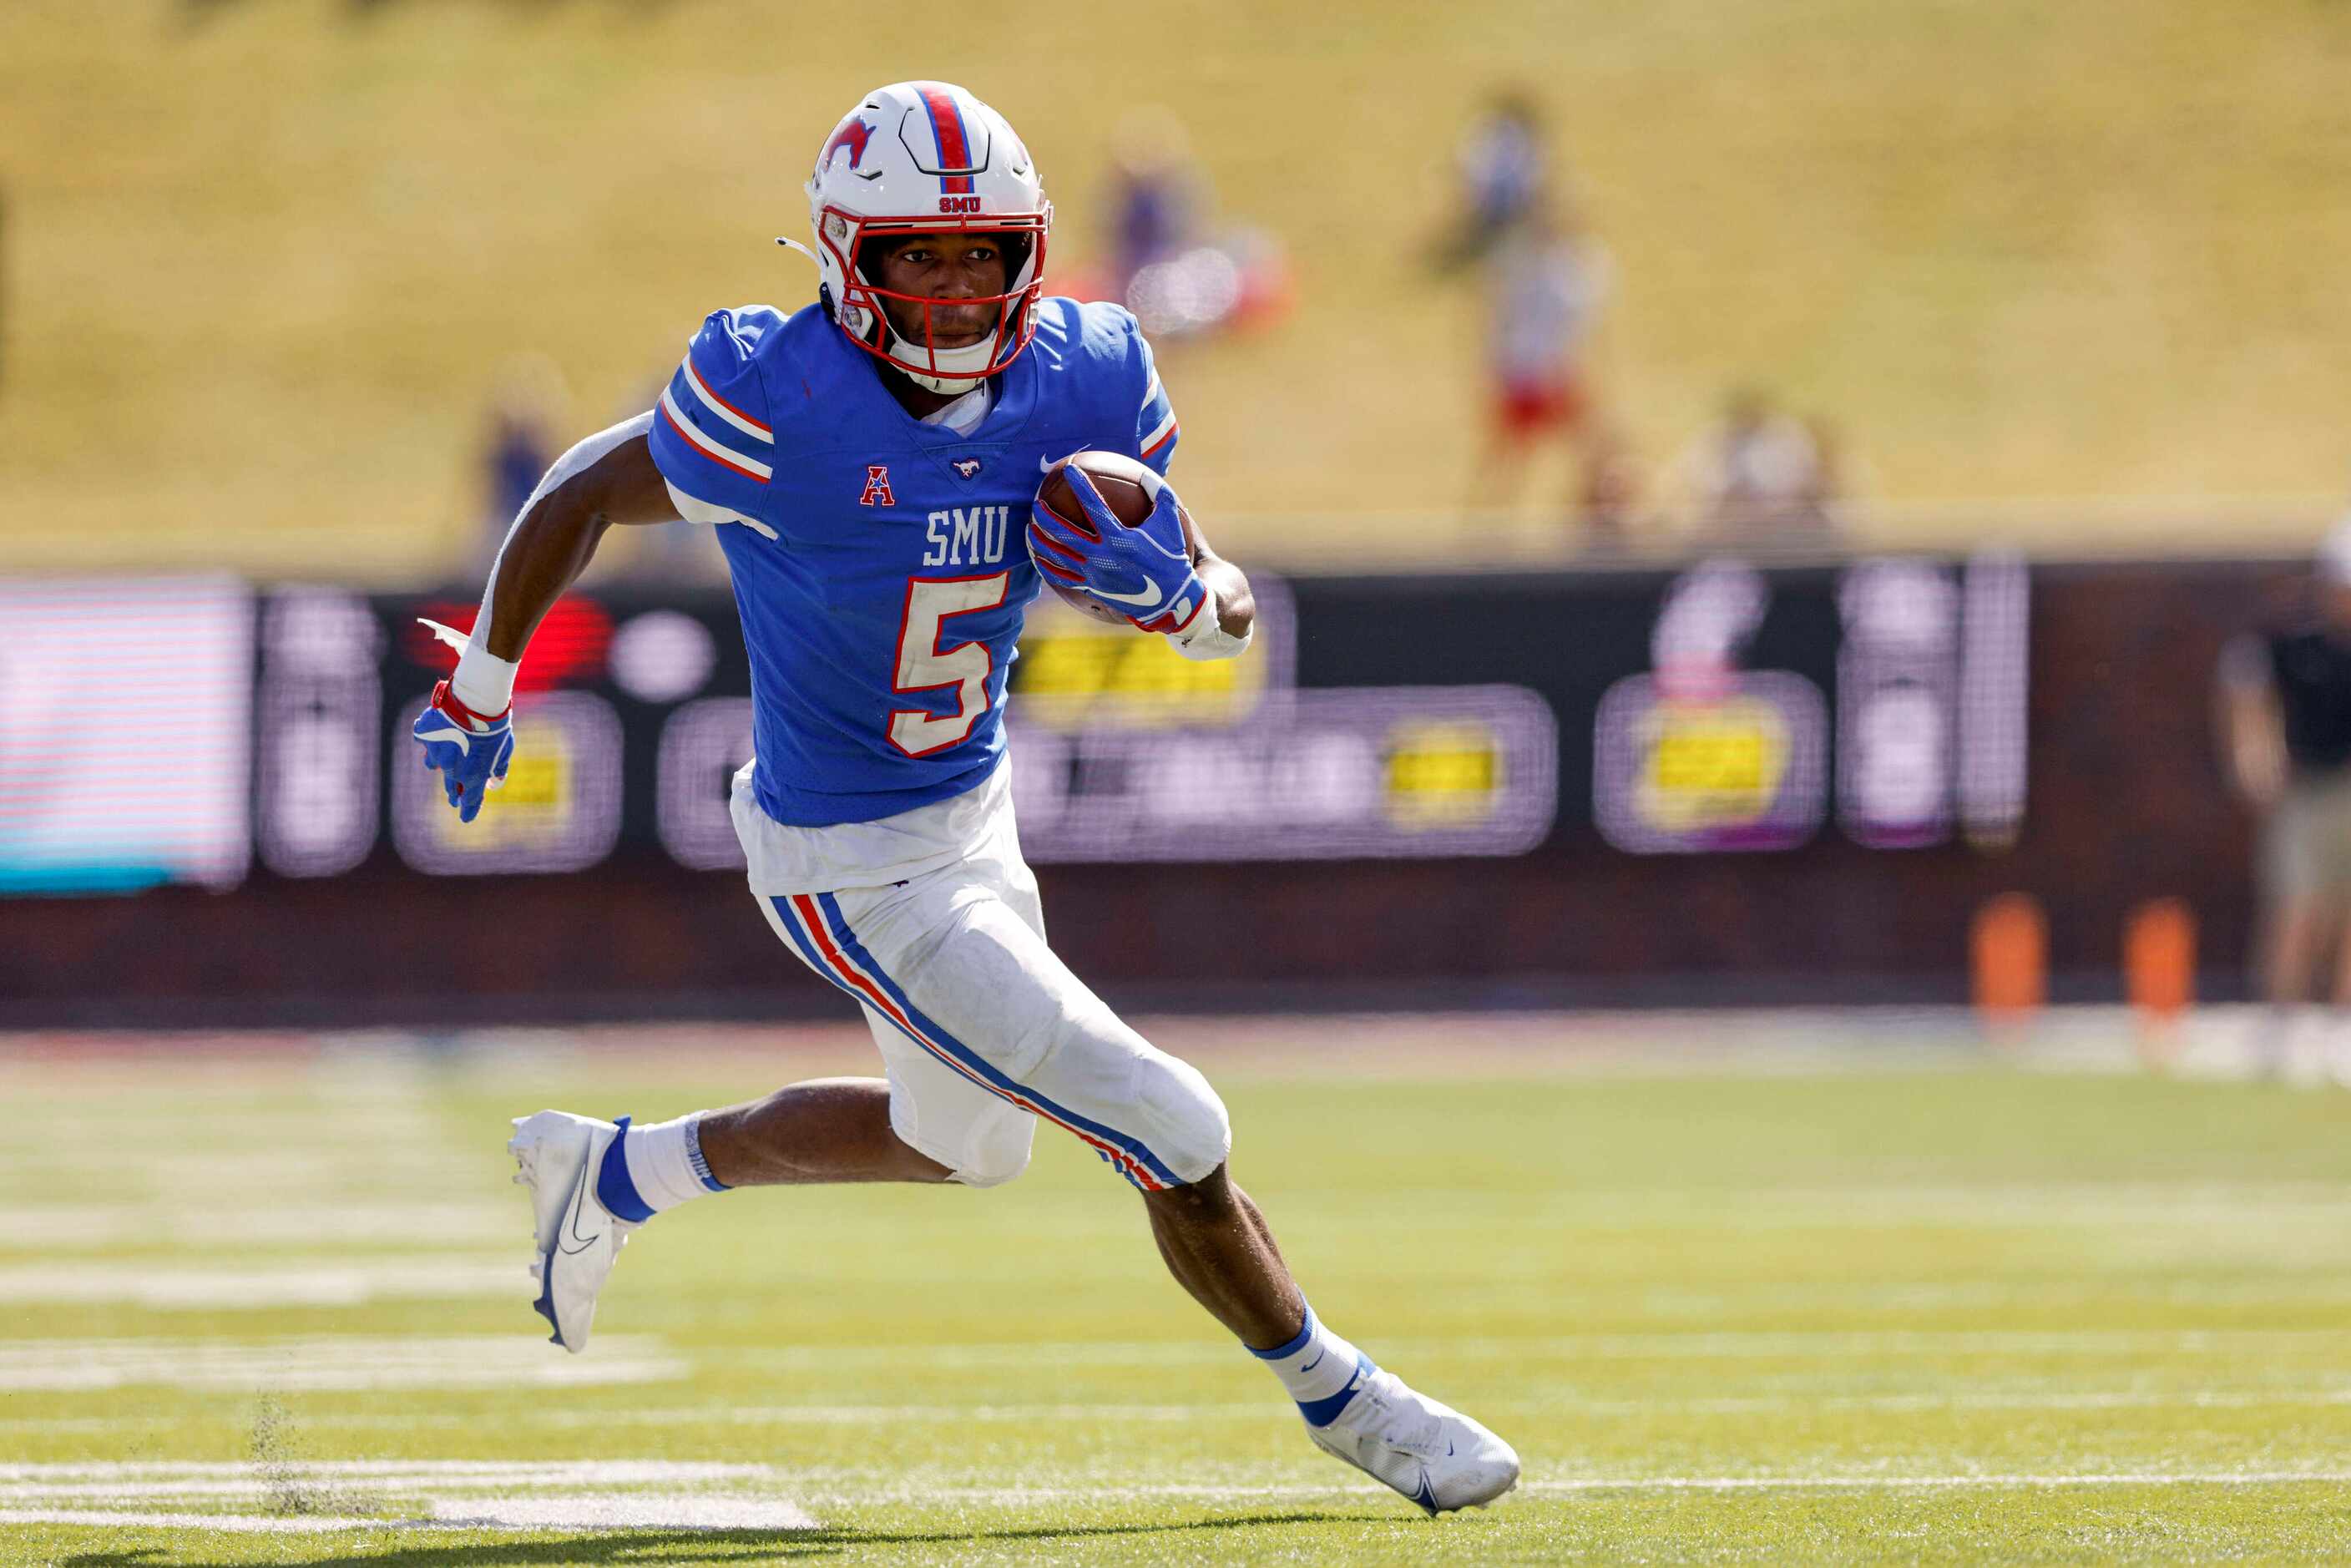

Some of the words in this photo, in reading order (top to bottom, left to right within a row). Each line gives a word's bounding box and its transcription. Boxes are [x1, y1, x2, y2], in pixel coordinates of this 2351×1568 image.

[940, 197, 981, 213] SMU
[860, 466, 895, 506] A
[923, 507, 1009, 566] SMU
[887, 571, 1009, 757] 5
